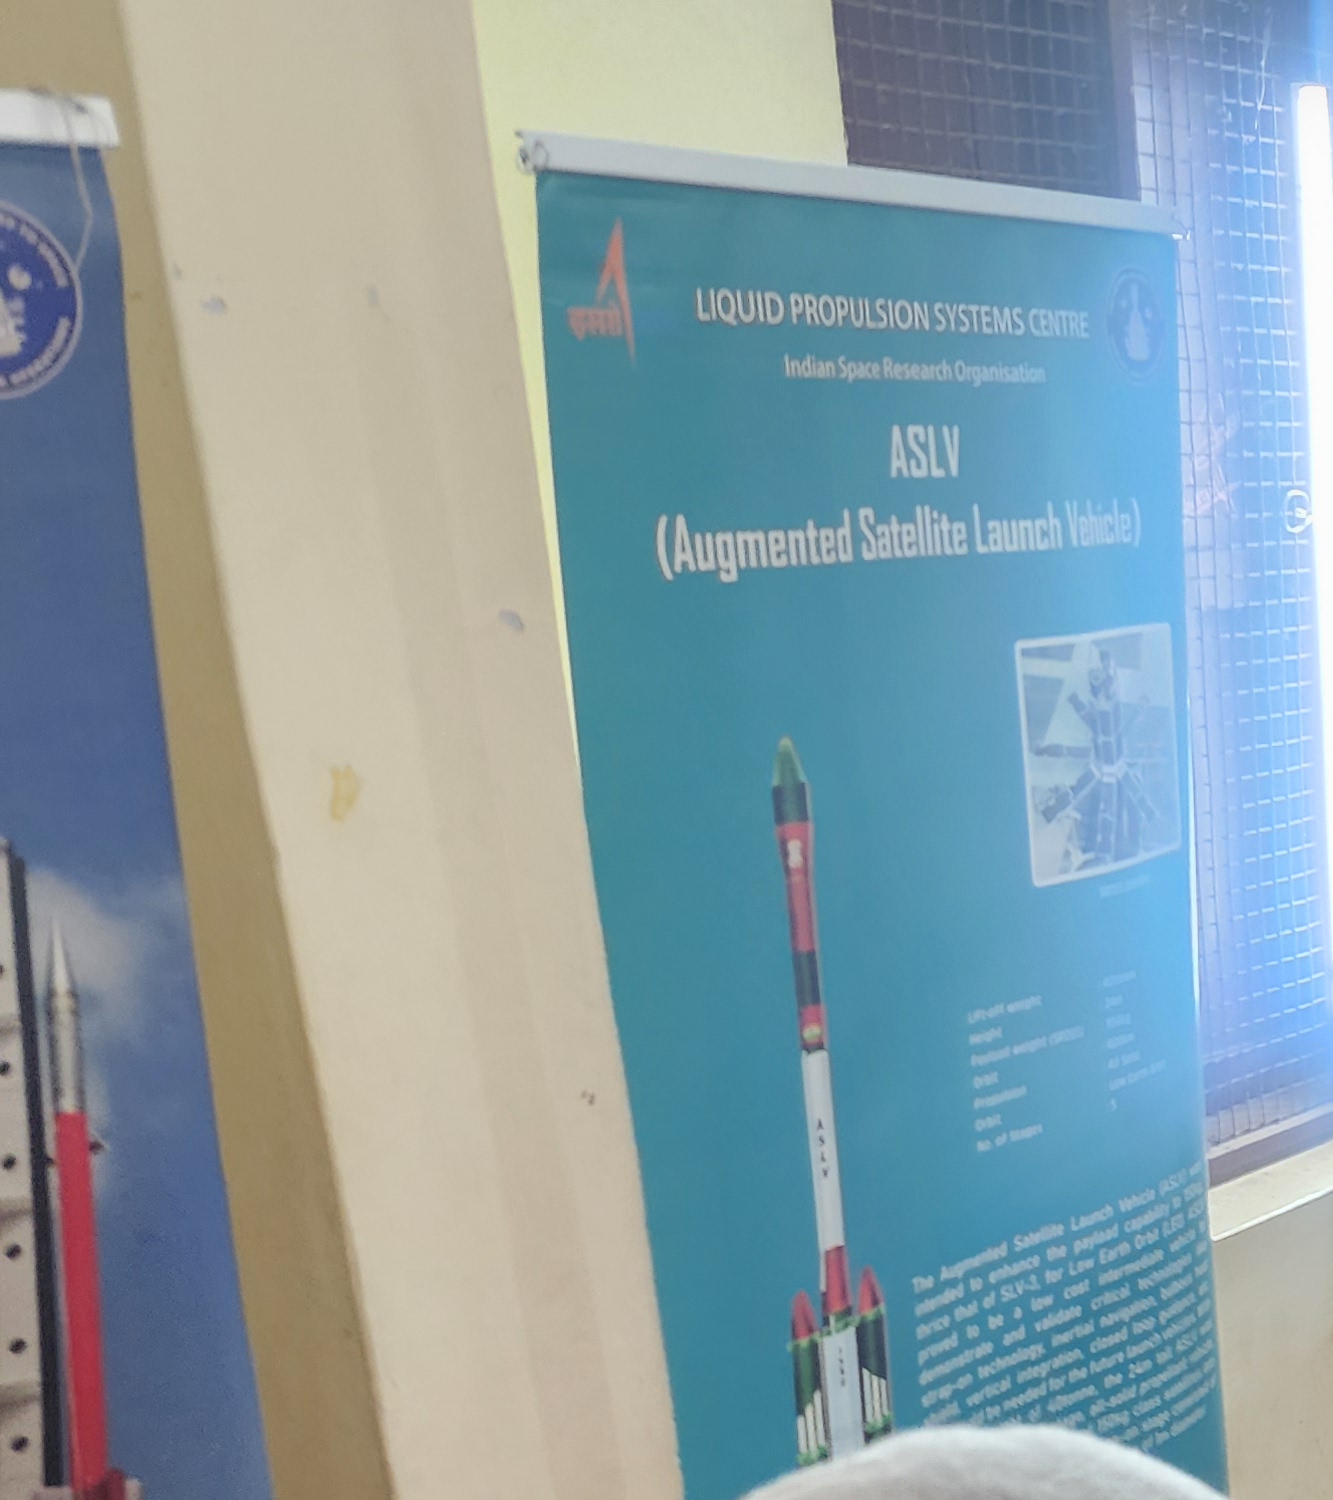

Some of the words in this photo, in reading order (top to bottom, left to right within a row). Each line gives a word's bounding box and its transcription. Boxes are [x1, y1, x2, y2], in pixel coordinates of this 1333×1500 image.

[696, 287, 785, 326] LIQUID
[790, 293, 930, 332] PROPULSION
[935, 302, 1025, 337] SYSTEMS
[1029, 309, 1090, 339] CENTRE
[784, 354, 835, 379] Indian
[838, 358, 881, 384] Space
[883, 359, 953, 382] Research
[955, 362, 1046, 386] Organisation
[889, 425, 960, 478] ASLV
[656, 508, 853, 584] (Augmented
[859, 509, 967, 562] Satellite
[973, 502, 1063, 555] Launch
[1066, 497, 1141, 549] Vehicle)
